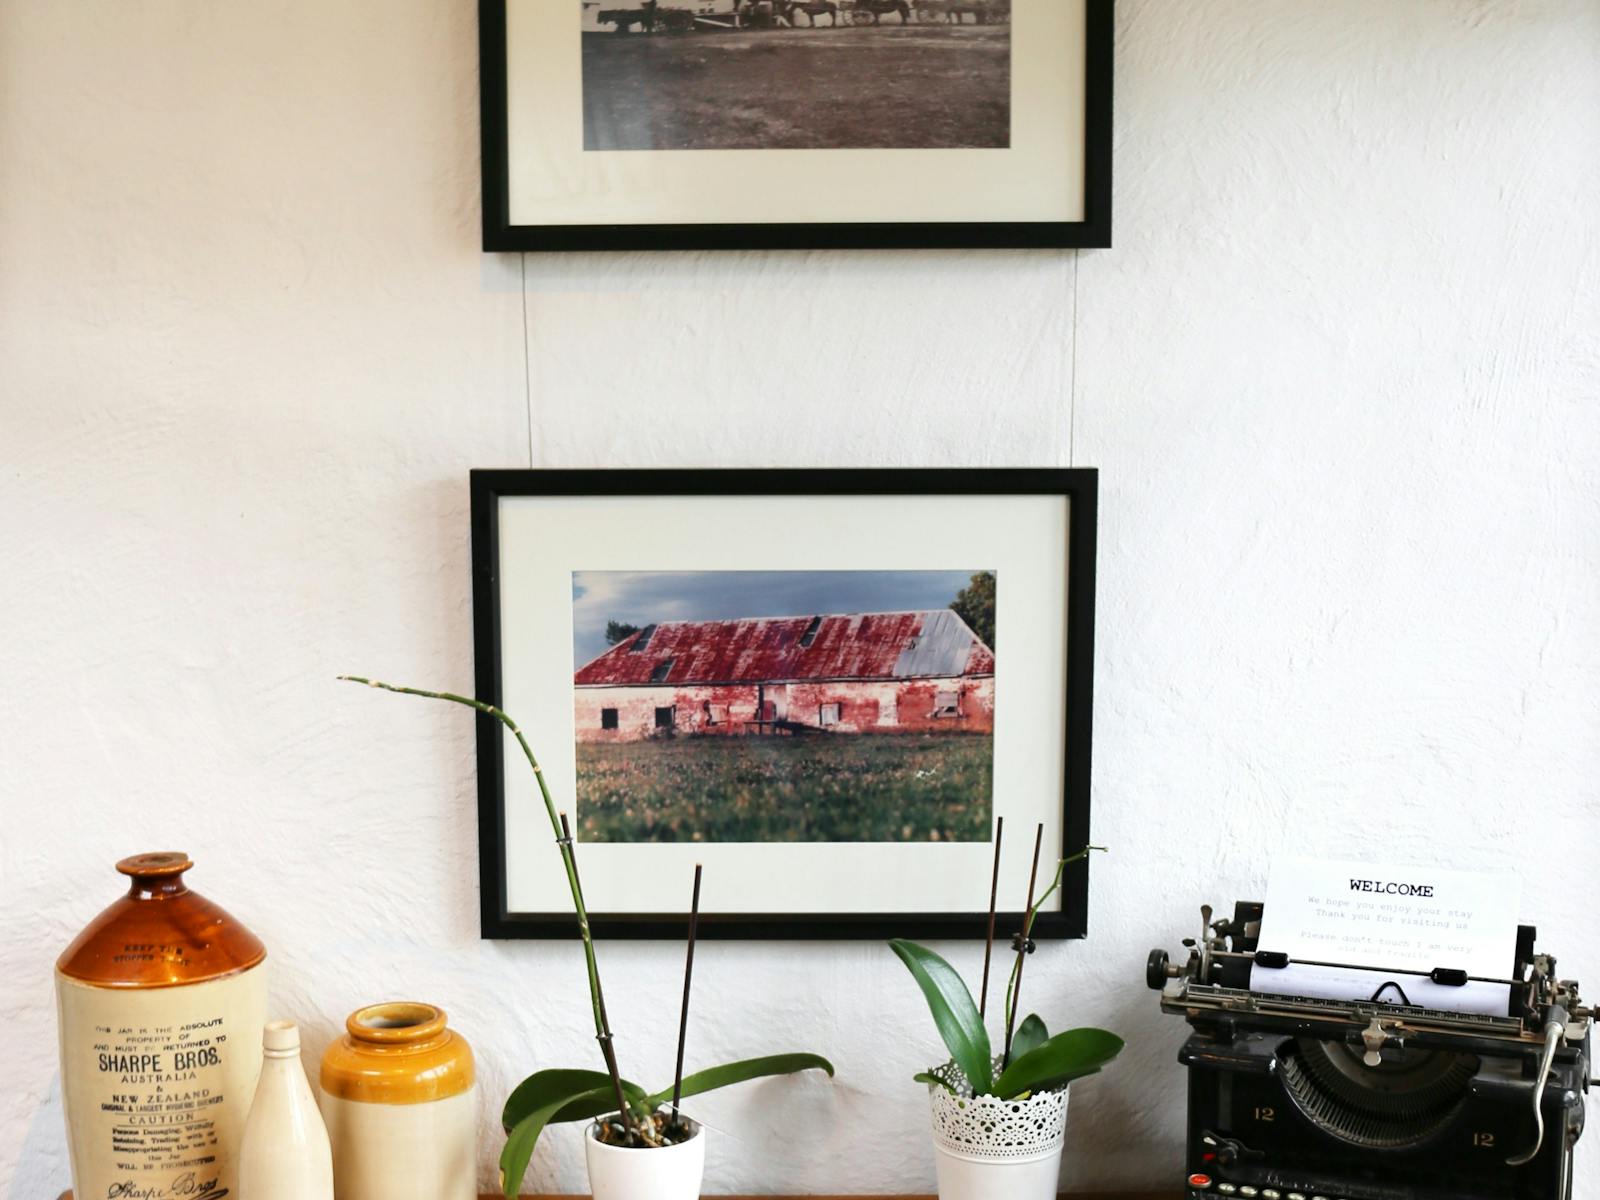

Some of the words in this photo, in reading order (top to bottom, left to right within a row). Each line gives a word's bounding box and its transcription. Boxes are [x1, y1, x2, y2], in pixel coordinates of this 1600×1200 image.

[1350, 879, 1434, 898] WELCOME
[1308, 896, 1320, 905] We
[1326, 897, 1350, 908] hope
[1356, 901, 1374, 911] you
[1380, 903, 1411, 914] enjoy
[1417, 907, 1441, 917] your
[1448, 909, 1473, 919] stay
[1315, 908, 1346, 919] Thank
[1352, 912, 1370, 922] you
[1376, 914, 1394, 923] for
[1401, 917, 1450, 929] visiting
[1456, 922, 1469, 930] us
[180, 1018, 223, 1031] ABSOLUTE
[163, 1039, 210, 1051] RETURNED
[215, 1035, 227, 1043] TO
[178, 1033, 190, 1041] OF
[99, 1053, 163, 1073] SHARPE
[174, 1046, 222, 1071] BROS.
[121, 1071, 197, 1083] AUSTRALIA
[112, 1094, 139, 1104] NEW
[147, 1089, 210, 1104] ZEALAND
[129, 1113, 195, 1125] CAUTION
[1254, 1108, 1275, 1121] 12
[1473, 1133, 1495, 1147] 12
